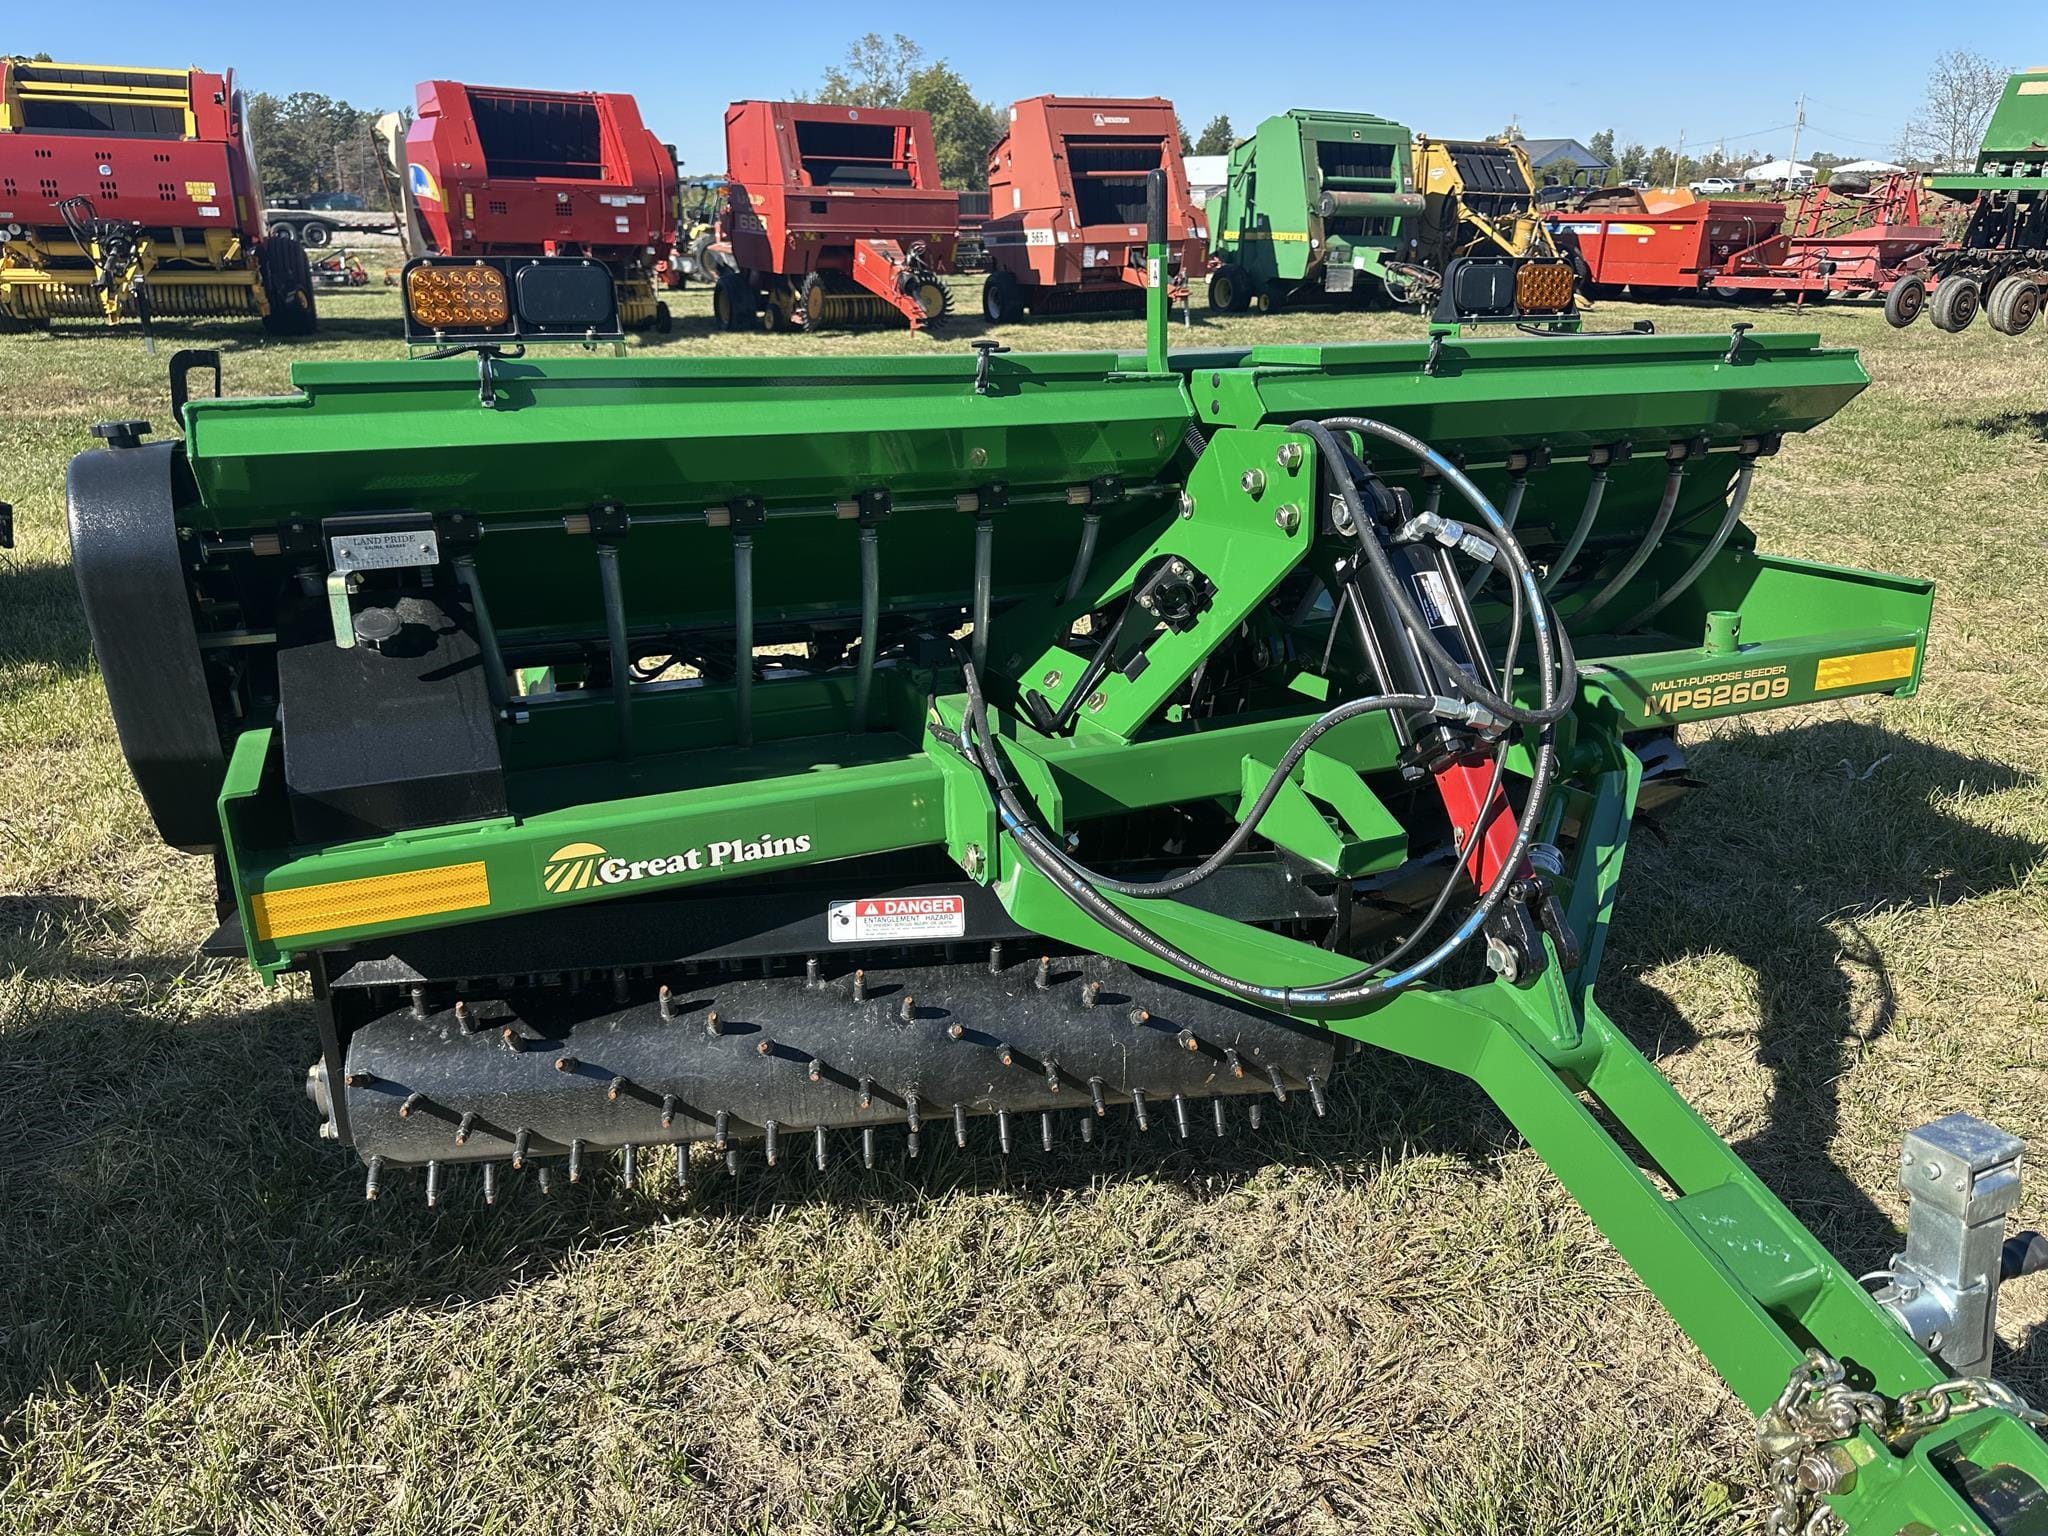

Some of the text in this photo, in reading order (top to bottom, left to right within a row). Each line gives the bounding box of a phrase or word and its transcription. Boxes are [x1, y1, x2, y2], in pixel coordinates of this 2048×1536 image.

[353, 535, 415, 545] LAND PRIDE
[1652, 666, 1786, 691] MULTI-PURPOSE SEEDER
[1644, 677, 1789, 716] MPS2609
[599, 834, 810, 884] Great Plains
[885, 899, 955, 914] DANGER
[864, 916, 919, 924] ENTANGLEMENT
